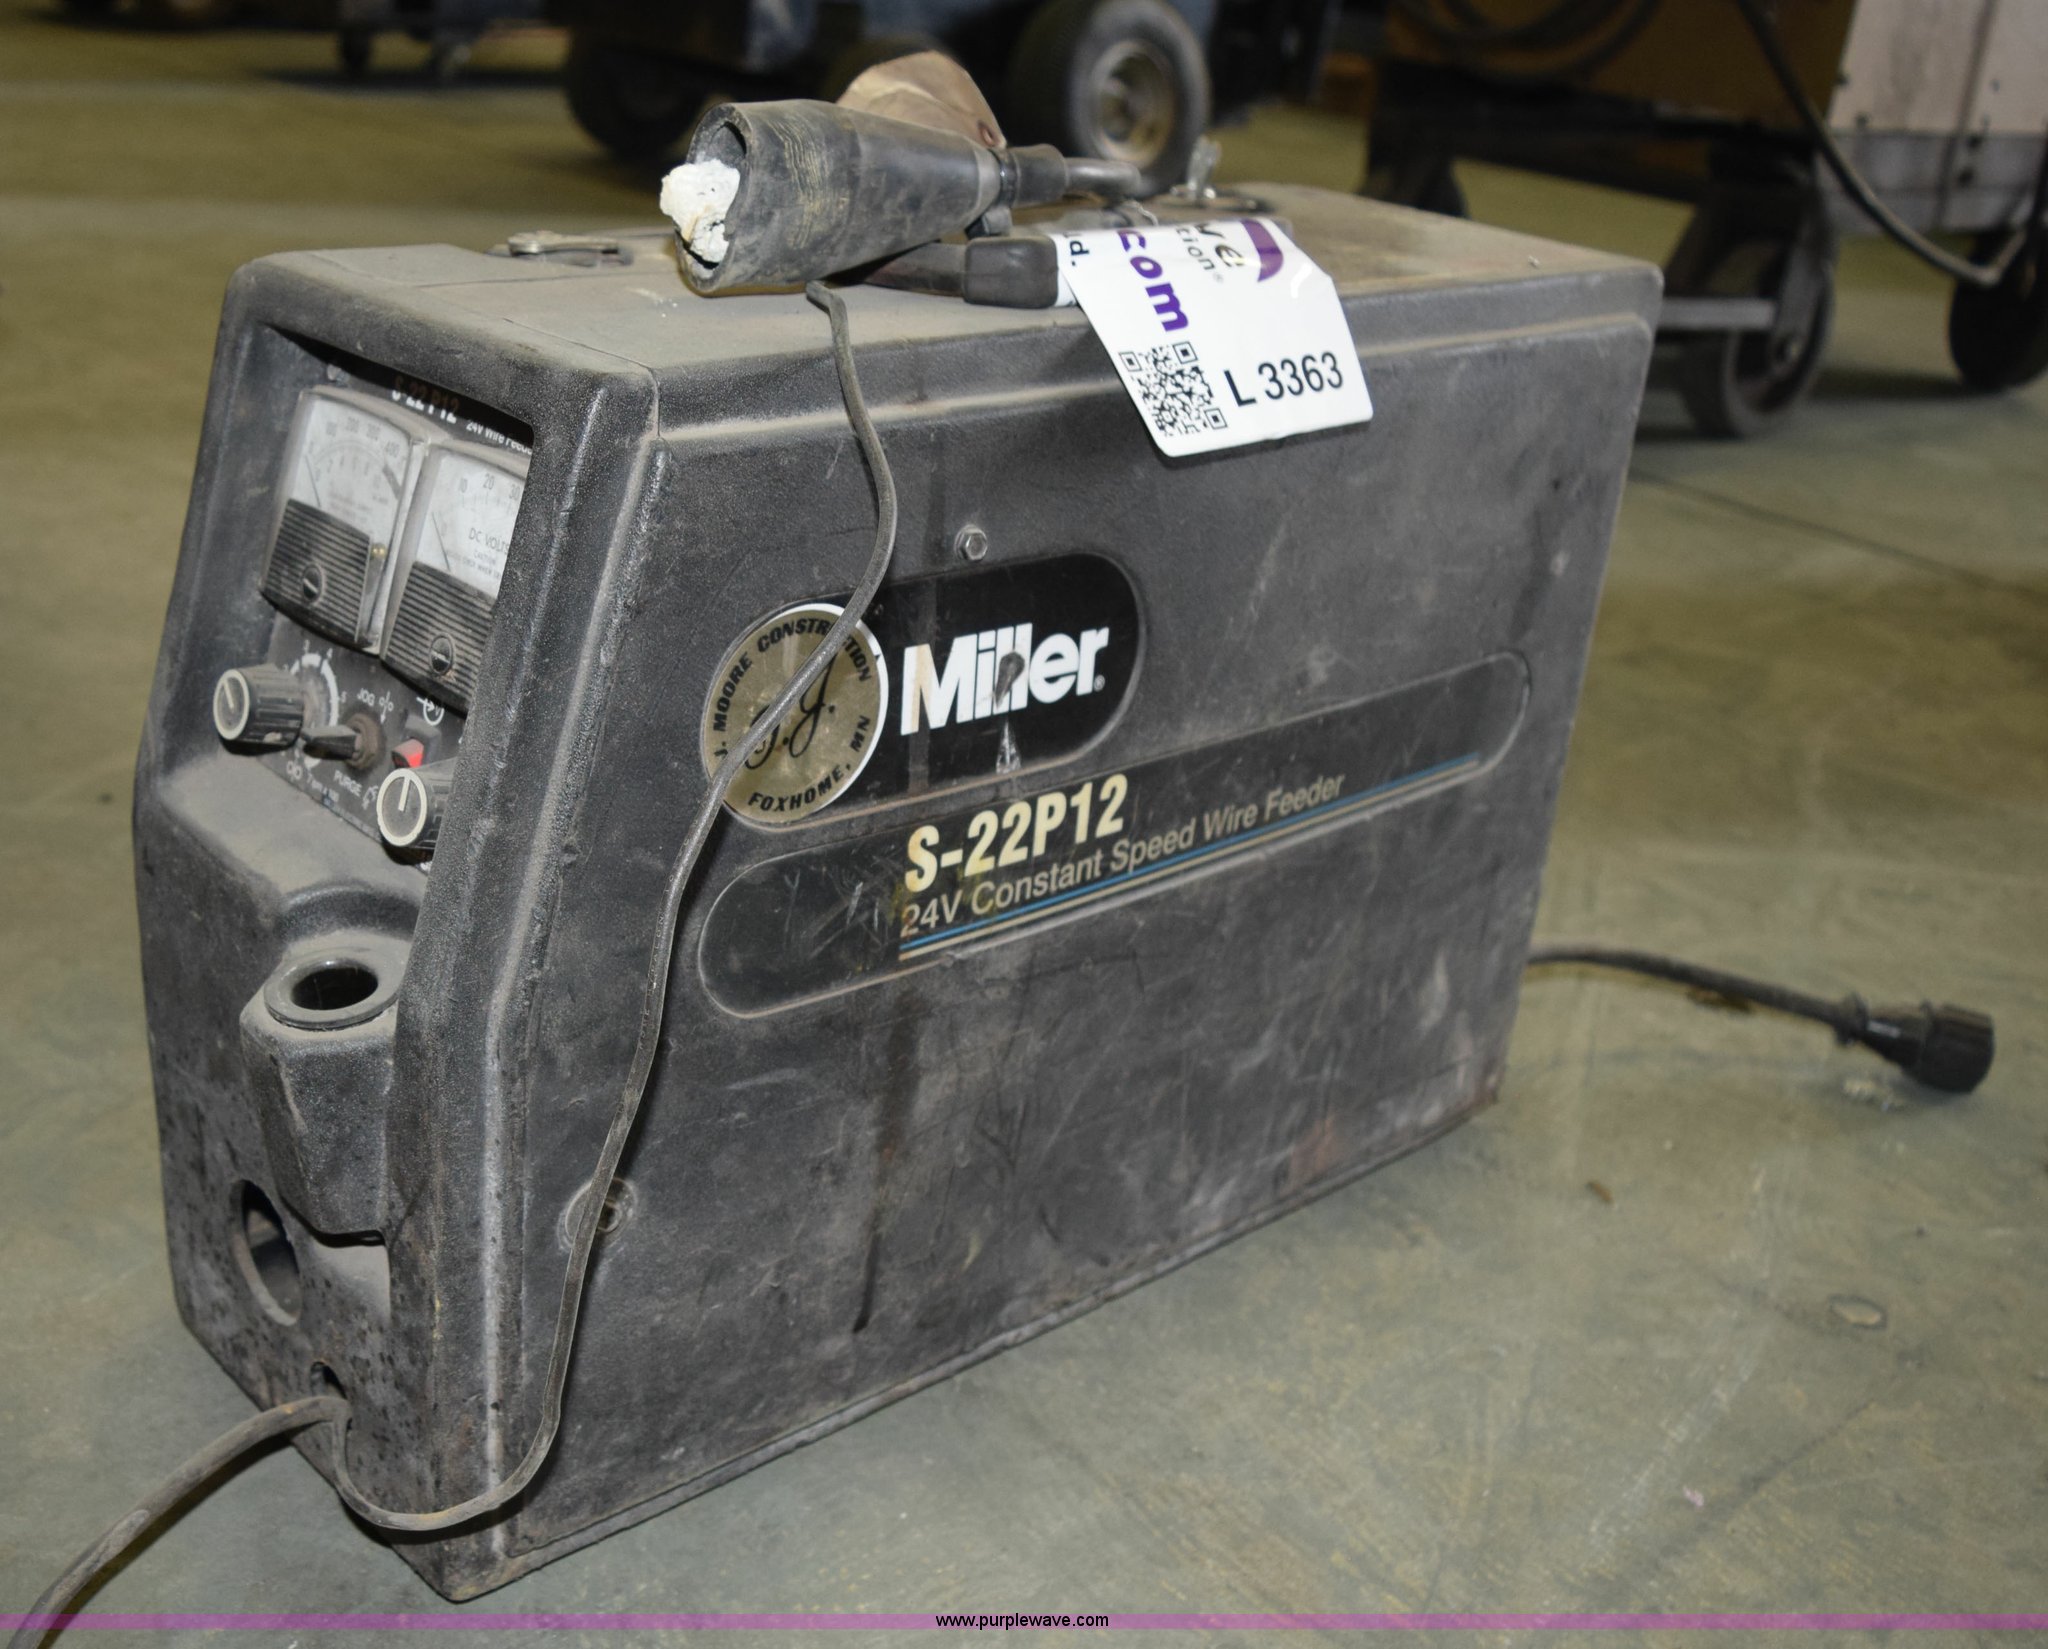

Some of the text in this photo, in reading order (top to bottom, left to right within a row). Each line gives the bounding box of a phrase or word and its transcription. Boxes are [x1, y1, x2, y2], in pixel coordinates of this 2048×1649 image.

[1224, 352, 1344, 407] L 3363
[483, 474, 495, 490] 20
[469, 528, 482, 542] DC
[357, 688, 375, 706] JOG
[713, 652, 752, 732] MOORE
[757, 617, 873, 682] CONSTRTION
[901, 622, 1110, 736] Miller
[851, 715, 871, 752] MN
[334, 769, 362, 797] PURGE
[905, 773, 1128, 893] S-22P12
[901, 775, 1345, 938] 24V Constant Speed Wire Feeder
